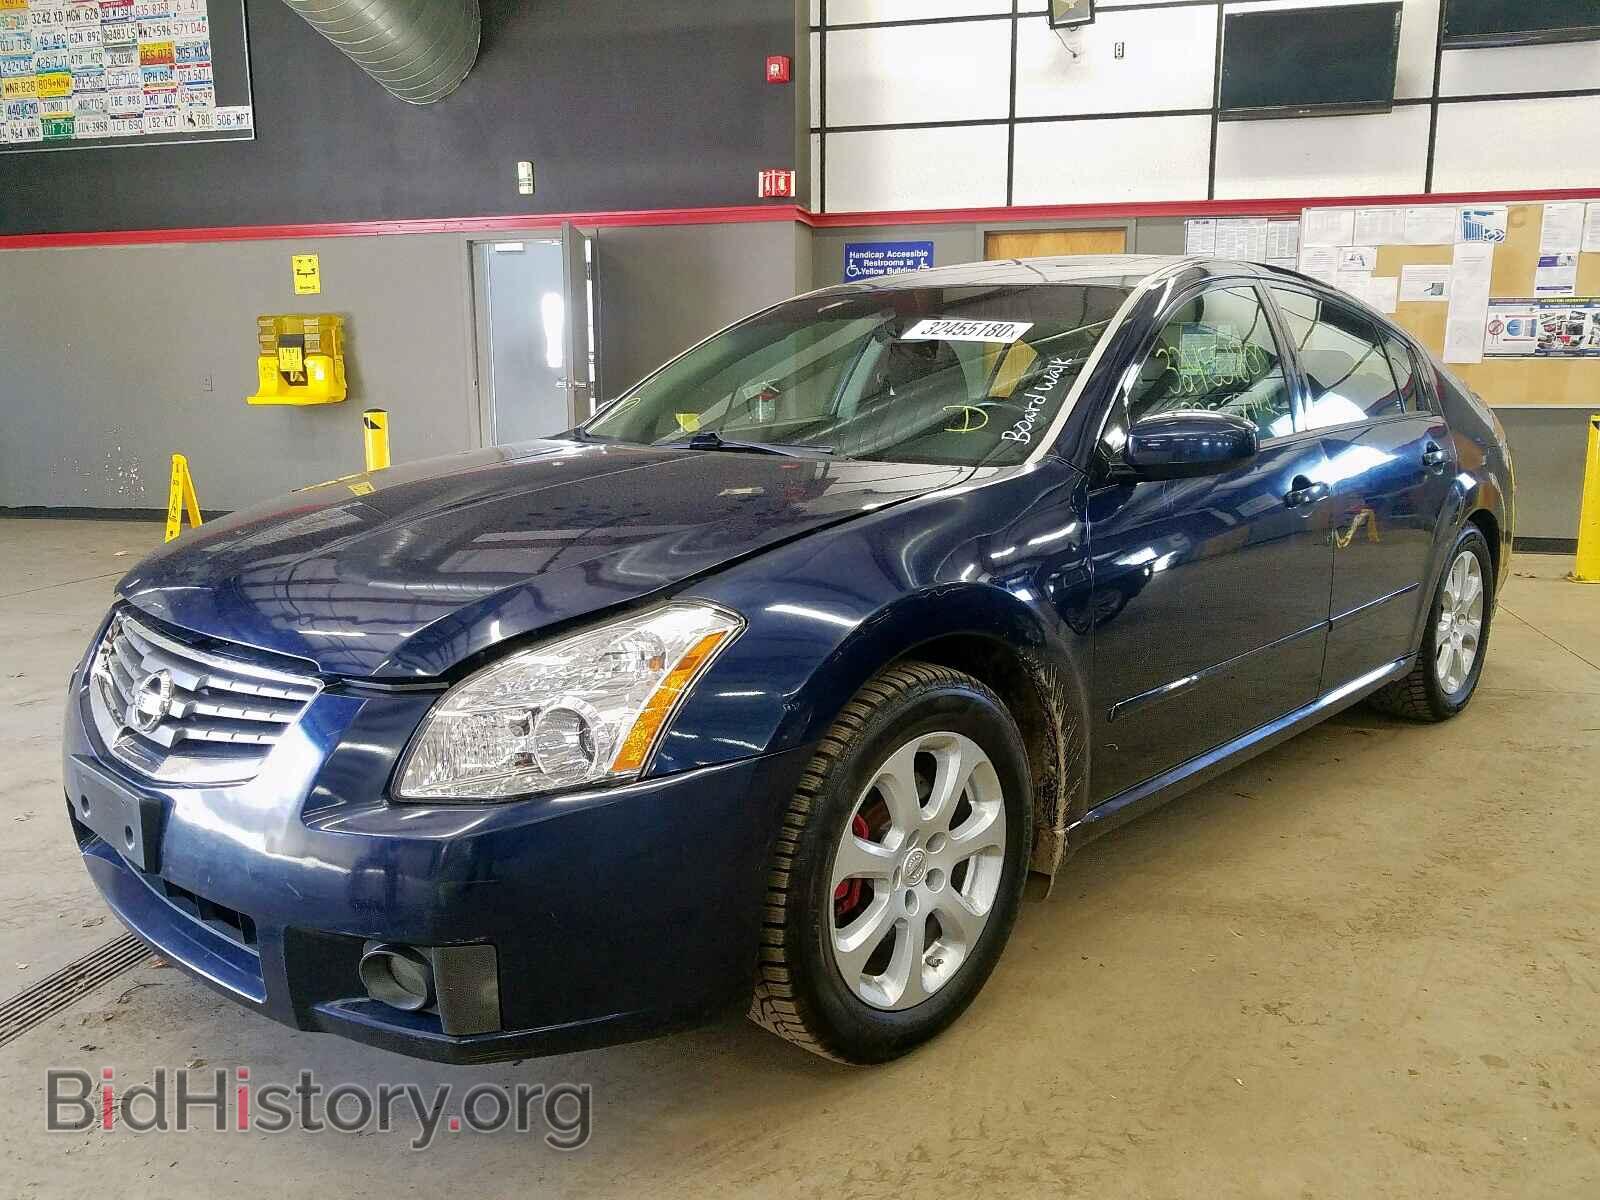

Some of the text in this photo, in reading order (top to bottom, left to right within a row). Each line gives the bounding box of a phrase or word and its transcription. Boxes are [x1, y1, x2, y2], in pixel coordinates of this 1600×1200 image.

[849, 249, 929, 259] Handicap Accessible
[863, 259, 904, 267] Restrooms
[861, 268, 885, 276] Yellow
[1001, 392, 1048, 445] Board
